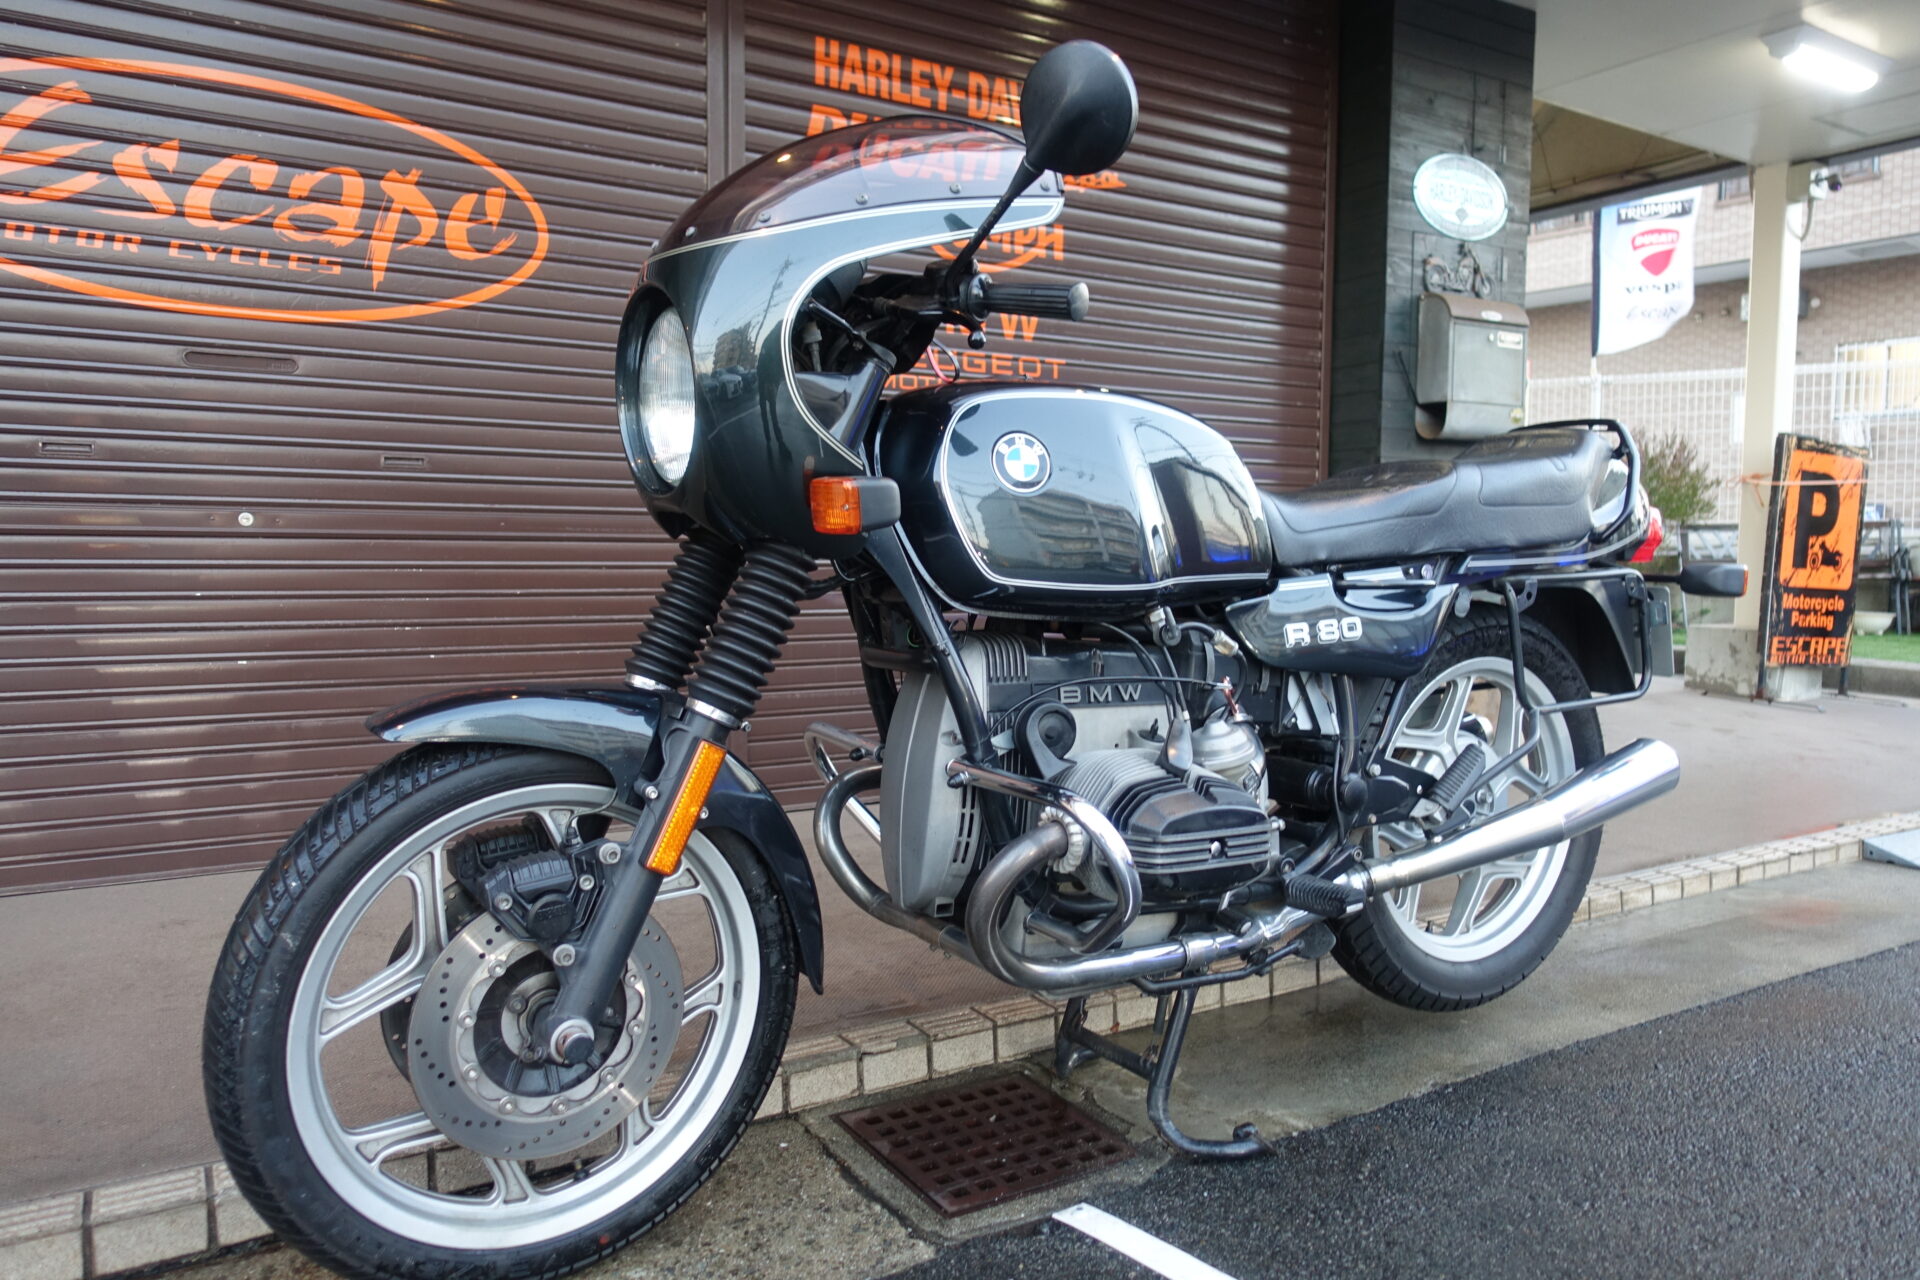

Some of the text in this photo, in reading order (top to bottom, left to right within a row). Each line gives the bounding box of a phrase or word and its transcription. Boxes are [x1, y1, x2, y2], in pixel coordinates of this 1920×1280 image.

[814, 36, 1022, 127] HARLEY-DAV
[1619, 202, 1683, 220] TRIUMPH
[2, 222, 343, 275] OTOR CYCLES
[914, 349, 1066, 379] UGEOT
[1792, 470, 1840, 569] P
[1782, 593, 1845, 613] Motorcycle
[1283, 616, 1362, 648] R 80
[1791, 610, 1834, 631] Parking
[1771, 636, 1846, 656] ESCAPE
[1060, 684, 1142, 704] BMW
